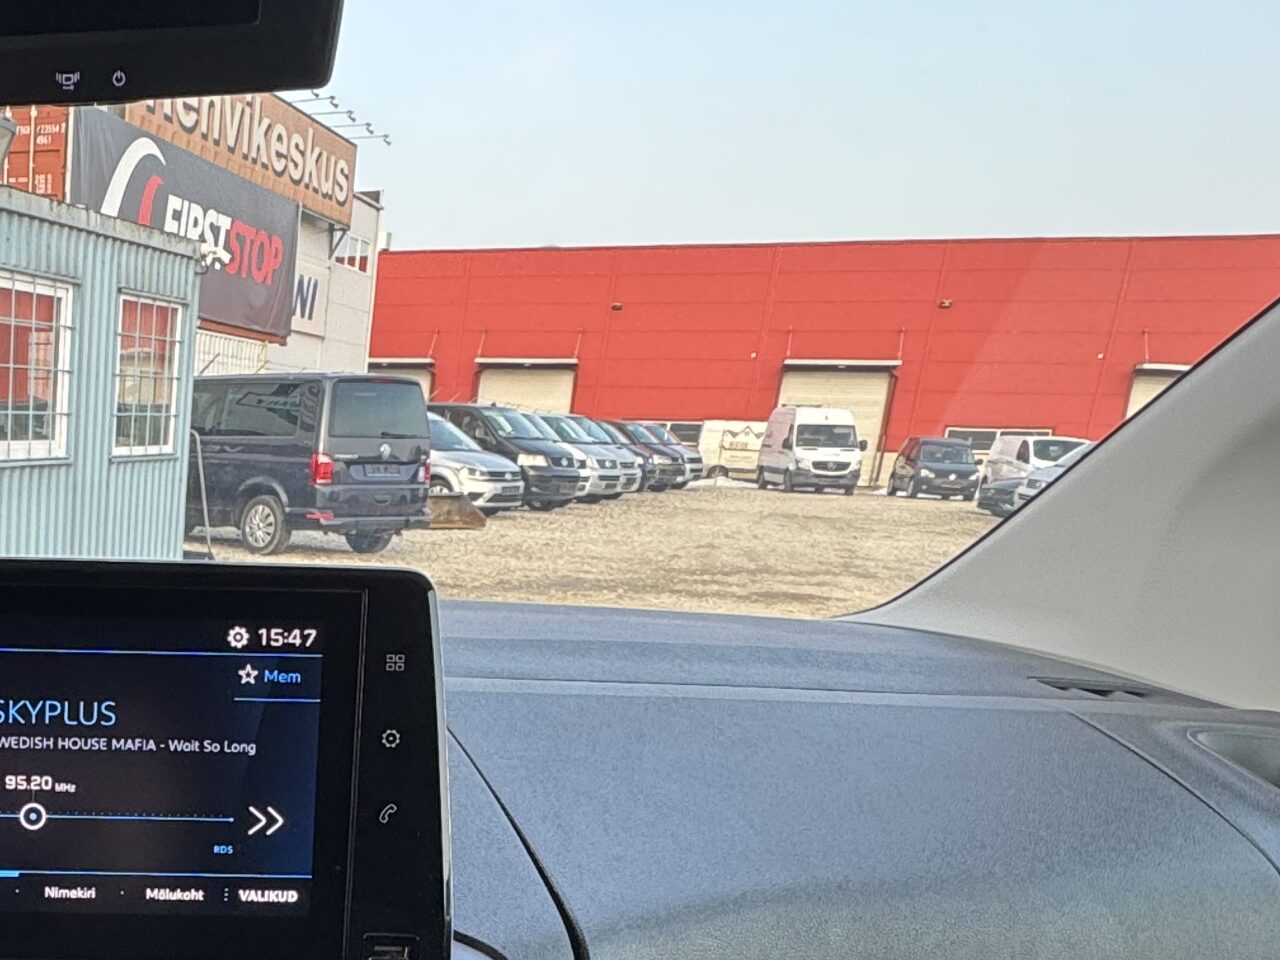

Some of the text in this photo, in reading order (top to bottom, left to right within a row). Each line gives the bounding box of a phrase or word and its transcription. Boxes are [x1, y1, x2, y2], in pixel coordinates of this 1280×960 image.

[258, 628, 317, 648] 15:47
[263, 670, 301, 684] Mem
[58, 737, 108, 750] HOUSE
[111, 739, 157, 752] MAFIA
[168, 740, 200, 753] Wait
[203, 740, 220, 753] So
[224, 741, 257, 756] Long
[5, 775, 76, 793] 95.20 MHz
[213, 845, 234, 854] RDS
[44, 886, 96, 900] Nimekiri
[238, 889, 299, 903] VALIKUD
